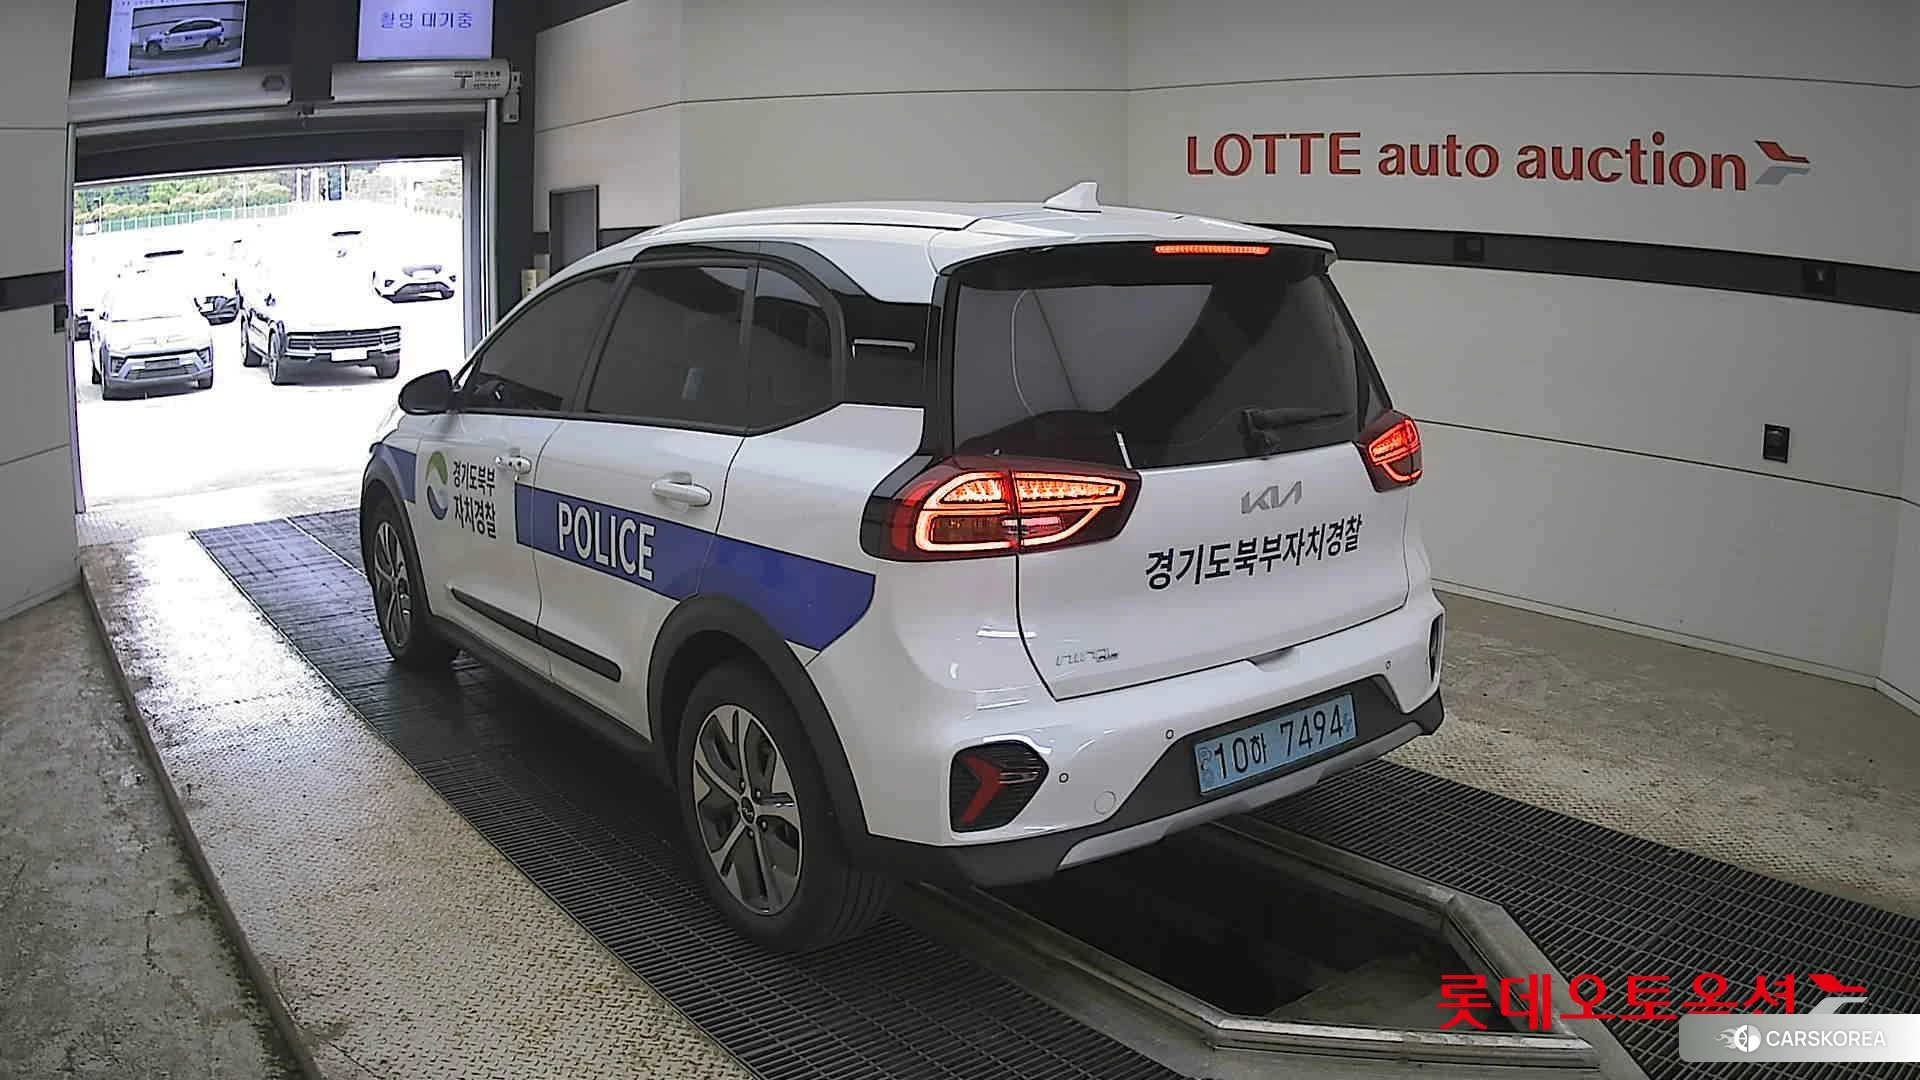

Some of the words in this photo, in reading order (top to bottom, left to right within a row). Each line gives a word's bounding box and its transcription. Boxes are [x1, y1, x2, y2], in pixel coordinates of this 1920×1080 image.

[421, 10, 473, 30] 대기중
[1187, 132, 1361, 176] LOTTE
[1378, 134, 1499, 178] auto
[1515, 131, 1747, 191] auction
[452, 461, 496, 497] 경기도북부
[1240, 481, 1302, 514] KIA
[453, 494, 497, 540] 자치경찰
[557, 501, 655, 581] POLICE
[1145, 513, 1363, 590] 경기도북부자치경찰
[1214, 732, 1267, 779] 10하
[1280, 704, 1344, 757] 7494
